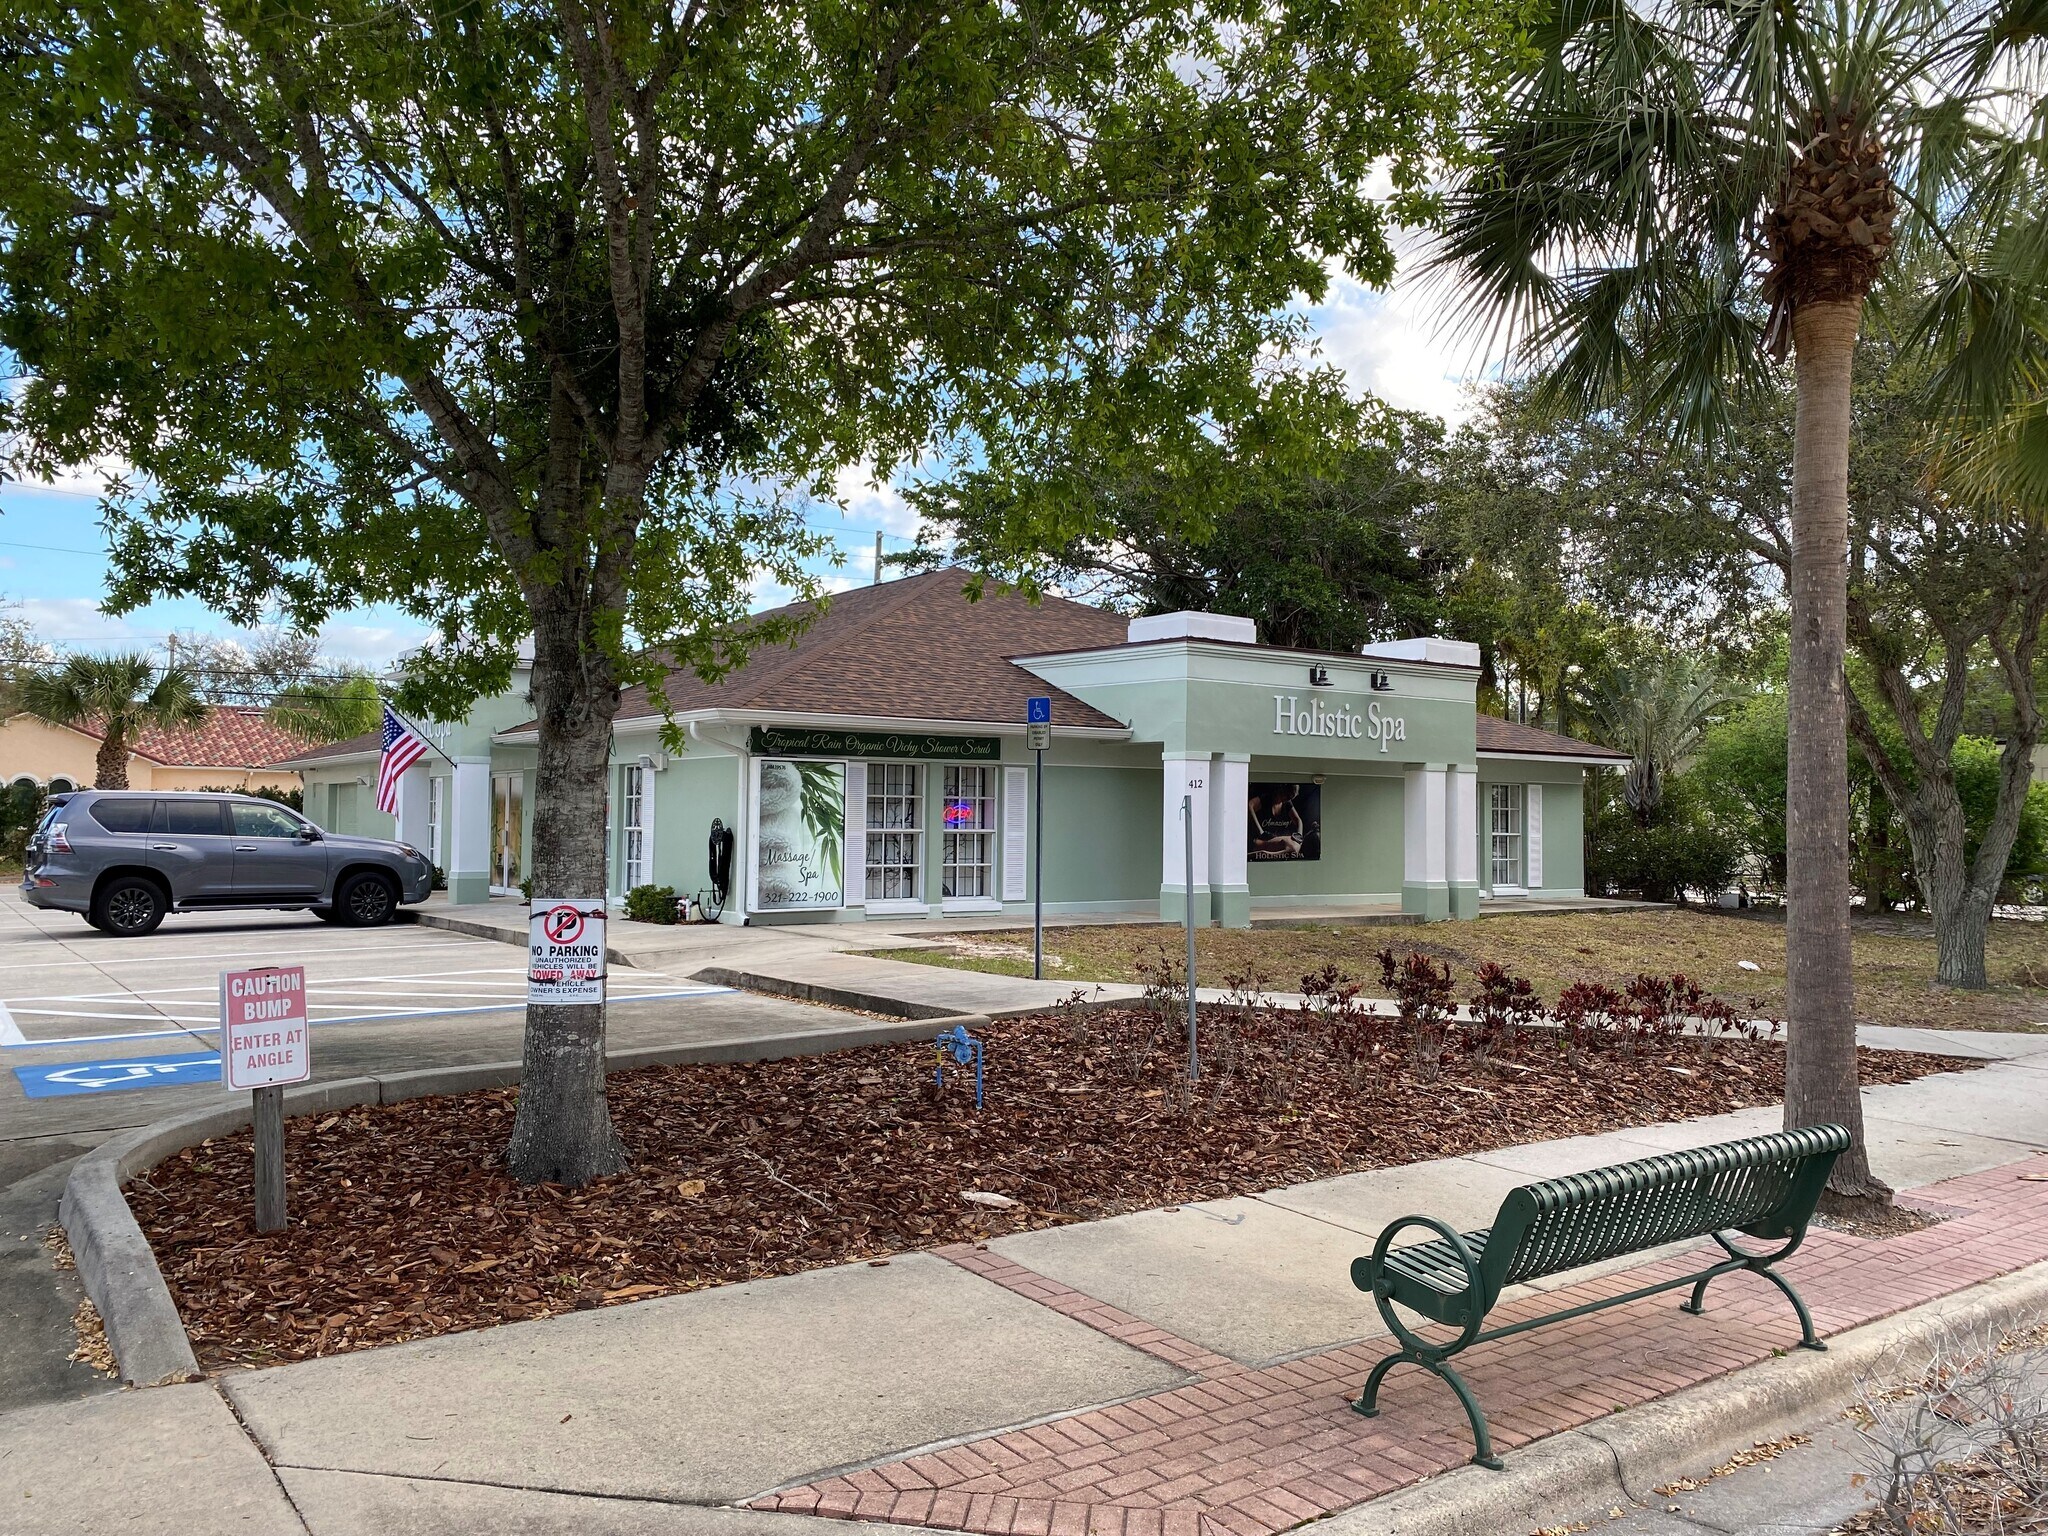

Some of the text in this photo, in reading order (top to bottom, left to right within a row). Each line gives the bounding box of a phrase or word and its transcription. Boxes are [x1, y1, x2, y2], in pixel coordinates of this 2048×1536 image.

[1273, 695, 1406, 753] Holistic Spa
[761, 732, 991, 756] Tropical Rain Organic Vichy Shower Scrub
[1188, 779, 1203, 789] 412
[765, 848, 810, 868] Massage
[798, 866, 819, 887] Spa
[763, 891, 839, 904] 321-222-1900
[531, 945, 599, 957] NO PARKING
[532, 969, 597, 980] TOWED AWAY
[231, 973, 301, 998] CAUTION
[562, 986, 598, 994] EXPENSE
[243, 998, 292, 1020] BUMP
[233, 1029, 302, 1051] ENTER AT
[246, 1050, 293, 1069] ANGLE
